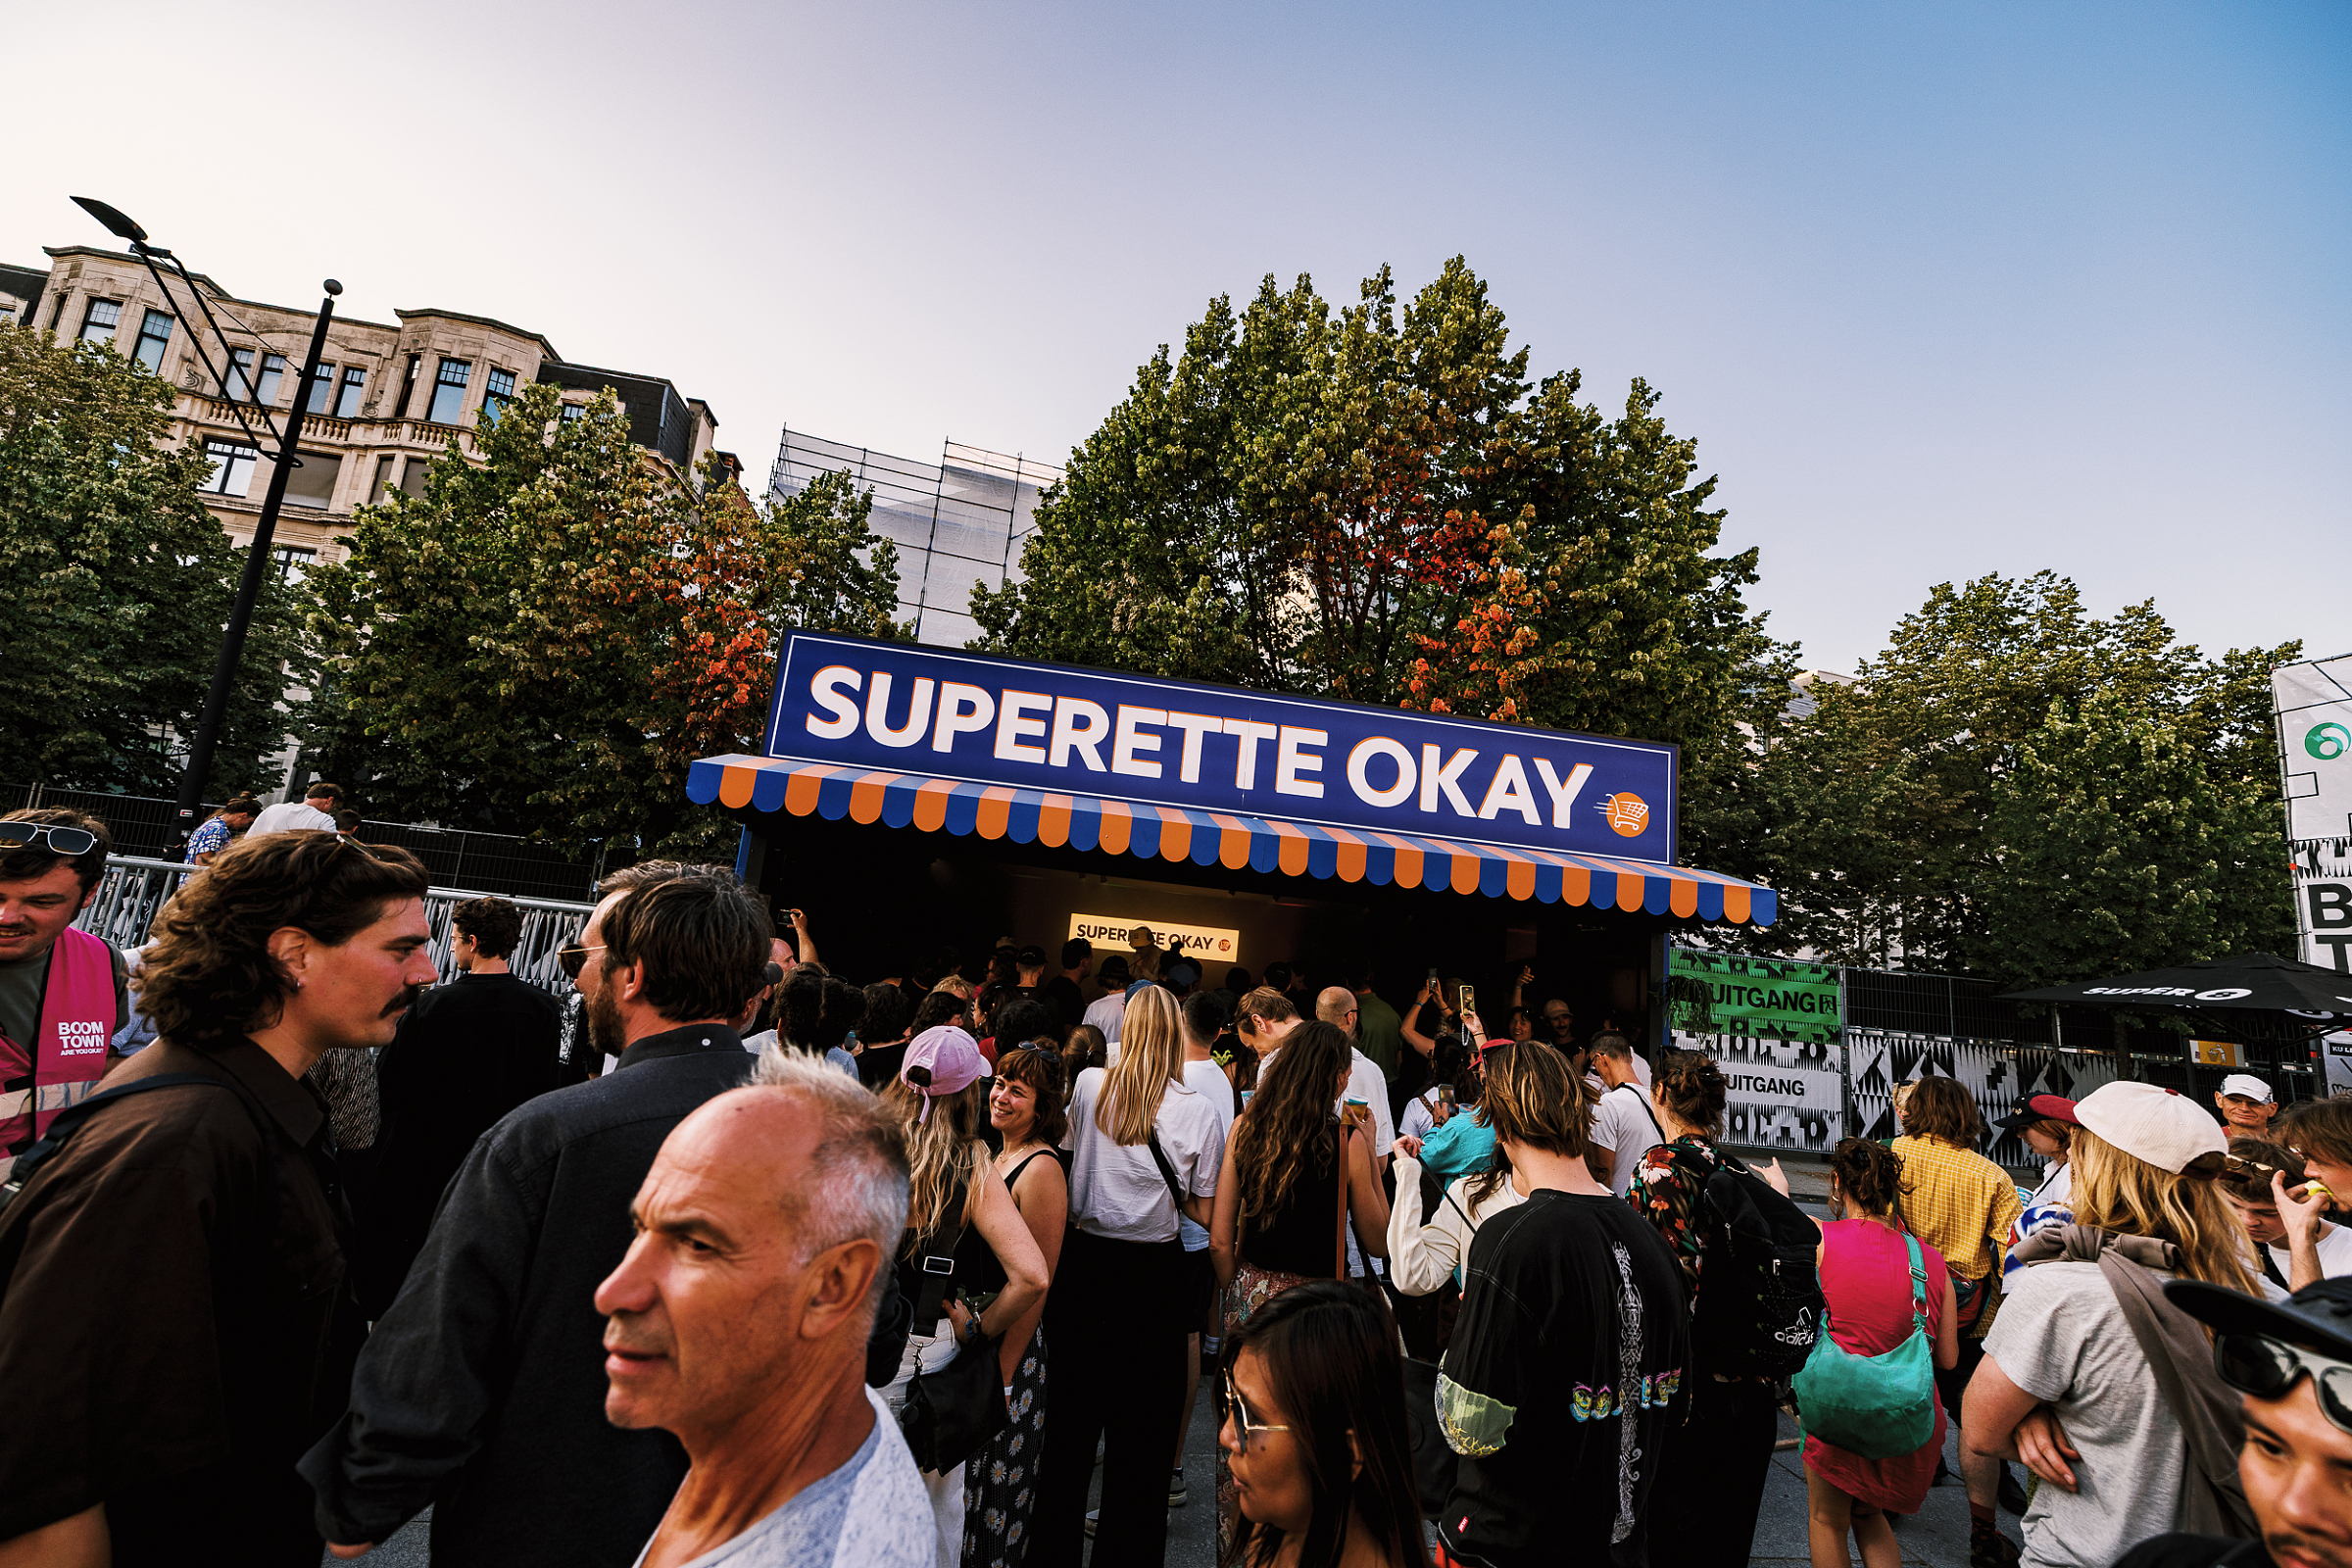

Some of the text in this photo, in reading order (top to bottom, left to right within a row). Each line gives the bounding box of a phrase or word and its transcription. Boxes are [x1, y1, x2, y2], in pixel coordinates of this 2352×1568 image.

[806, 664, 1593, 829] SUPERETTE OKAY
[1076, 923, 1214, 951] SUPERE OKAY
[1710, 982, 1816, 1013] UITGANG
[2082, 987, 2195, 997] SUPER
[58, 1021, 104, 1035] BOOM
[59, 1034, 105, 1049] TOWN
[1726, 1074, 1805, 1097] UITGANG
